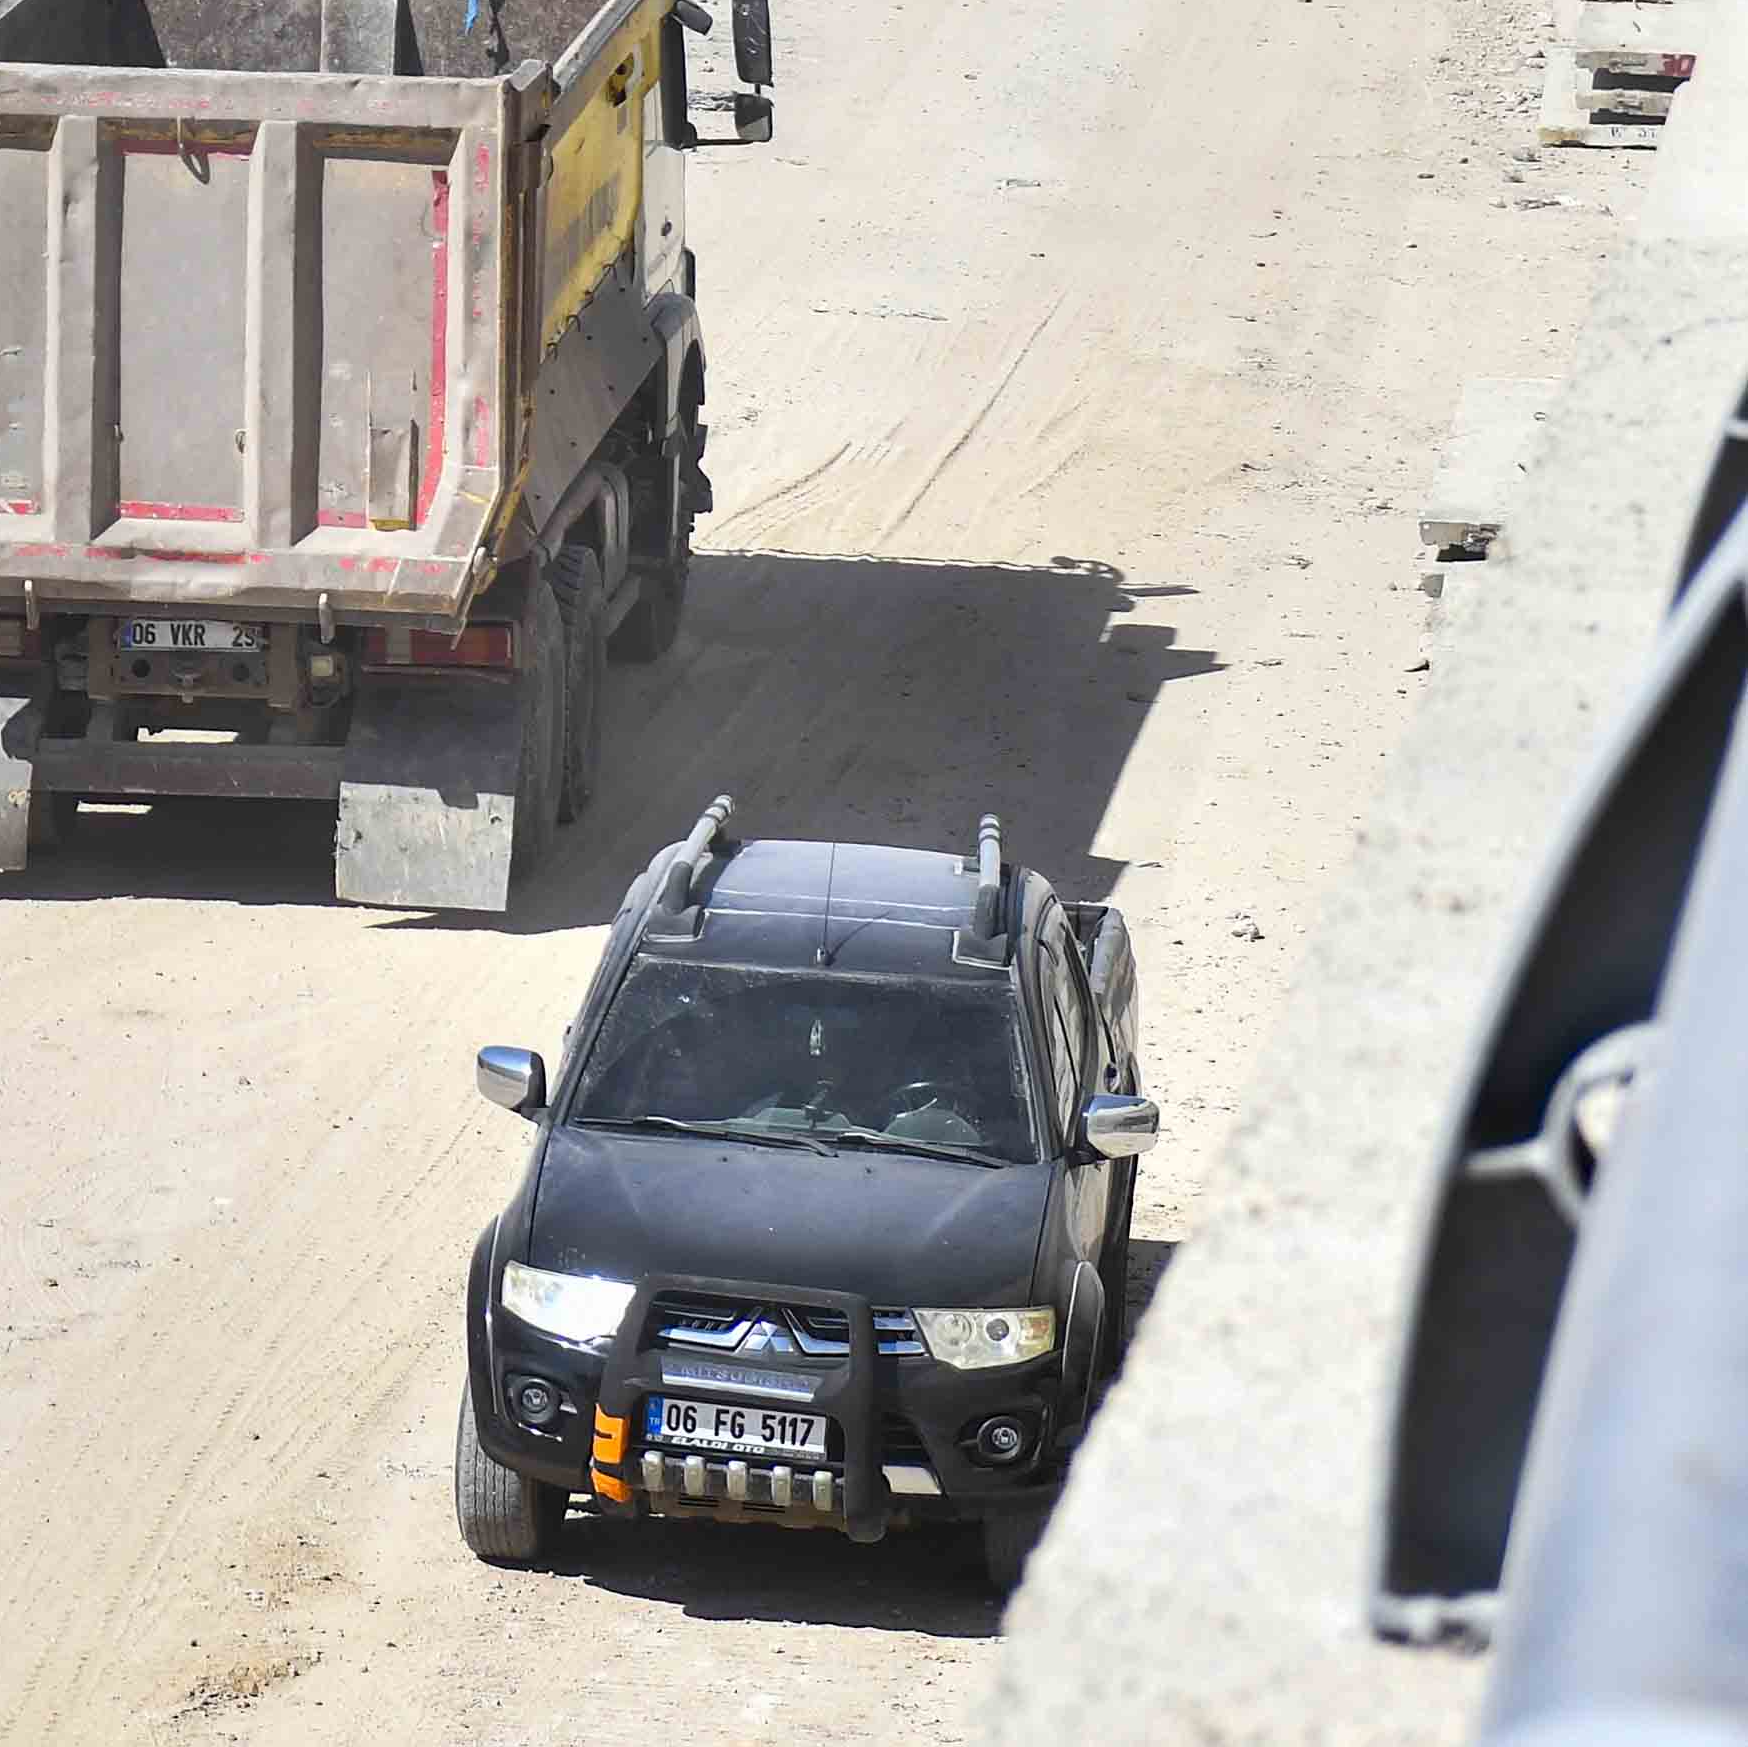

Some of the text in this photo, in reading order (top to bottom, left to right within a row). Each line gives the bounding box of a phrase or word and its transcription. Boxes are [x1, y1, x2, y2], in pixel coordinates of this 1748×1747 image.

[132, 623, 156, 645] 06
[170, 623, 206, 646] VKR
[666, 1403, 698, 1434] 06
[714, 1408, 746, 1439] FG
[761, 1414, 815, 1447] 5117
